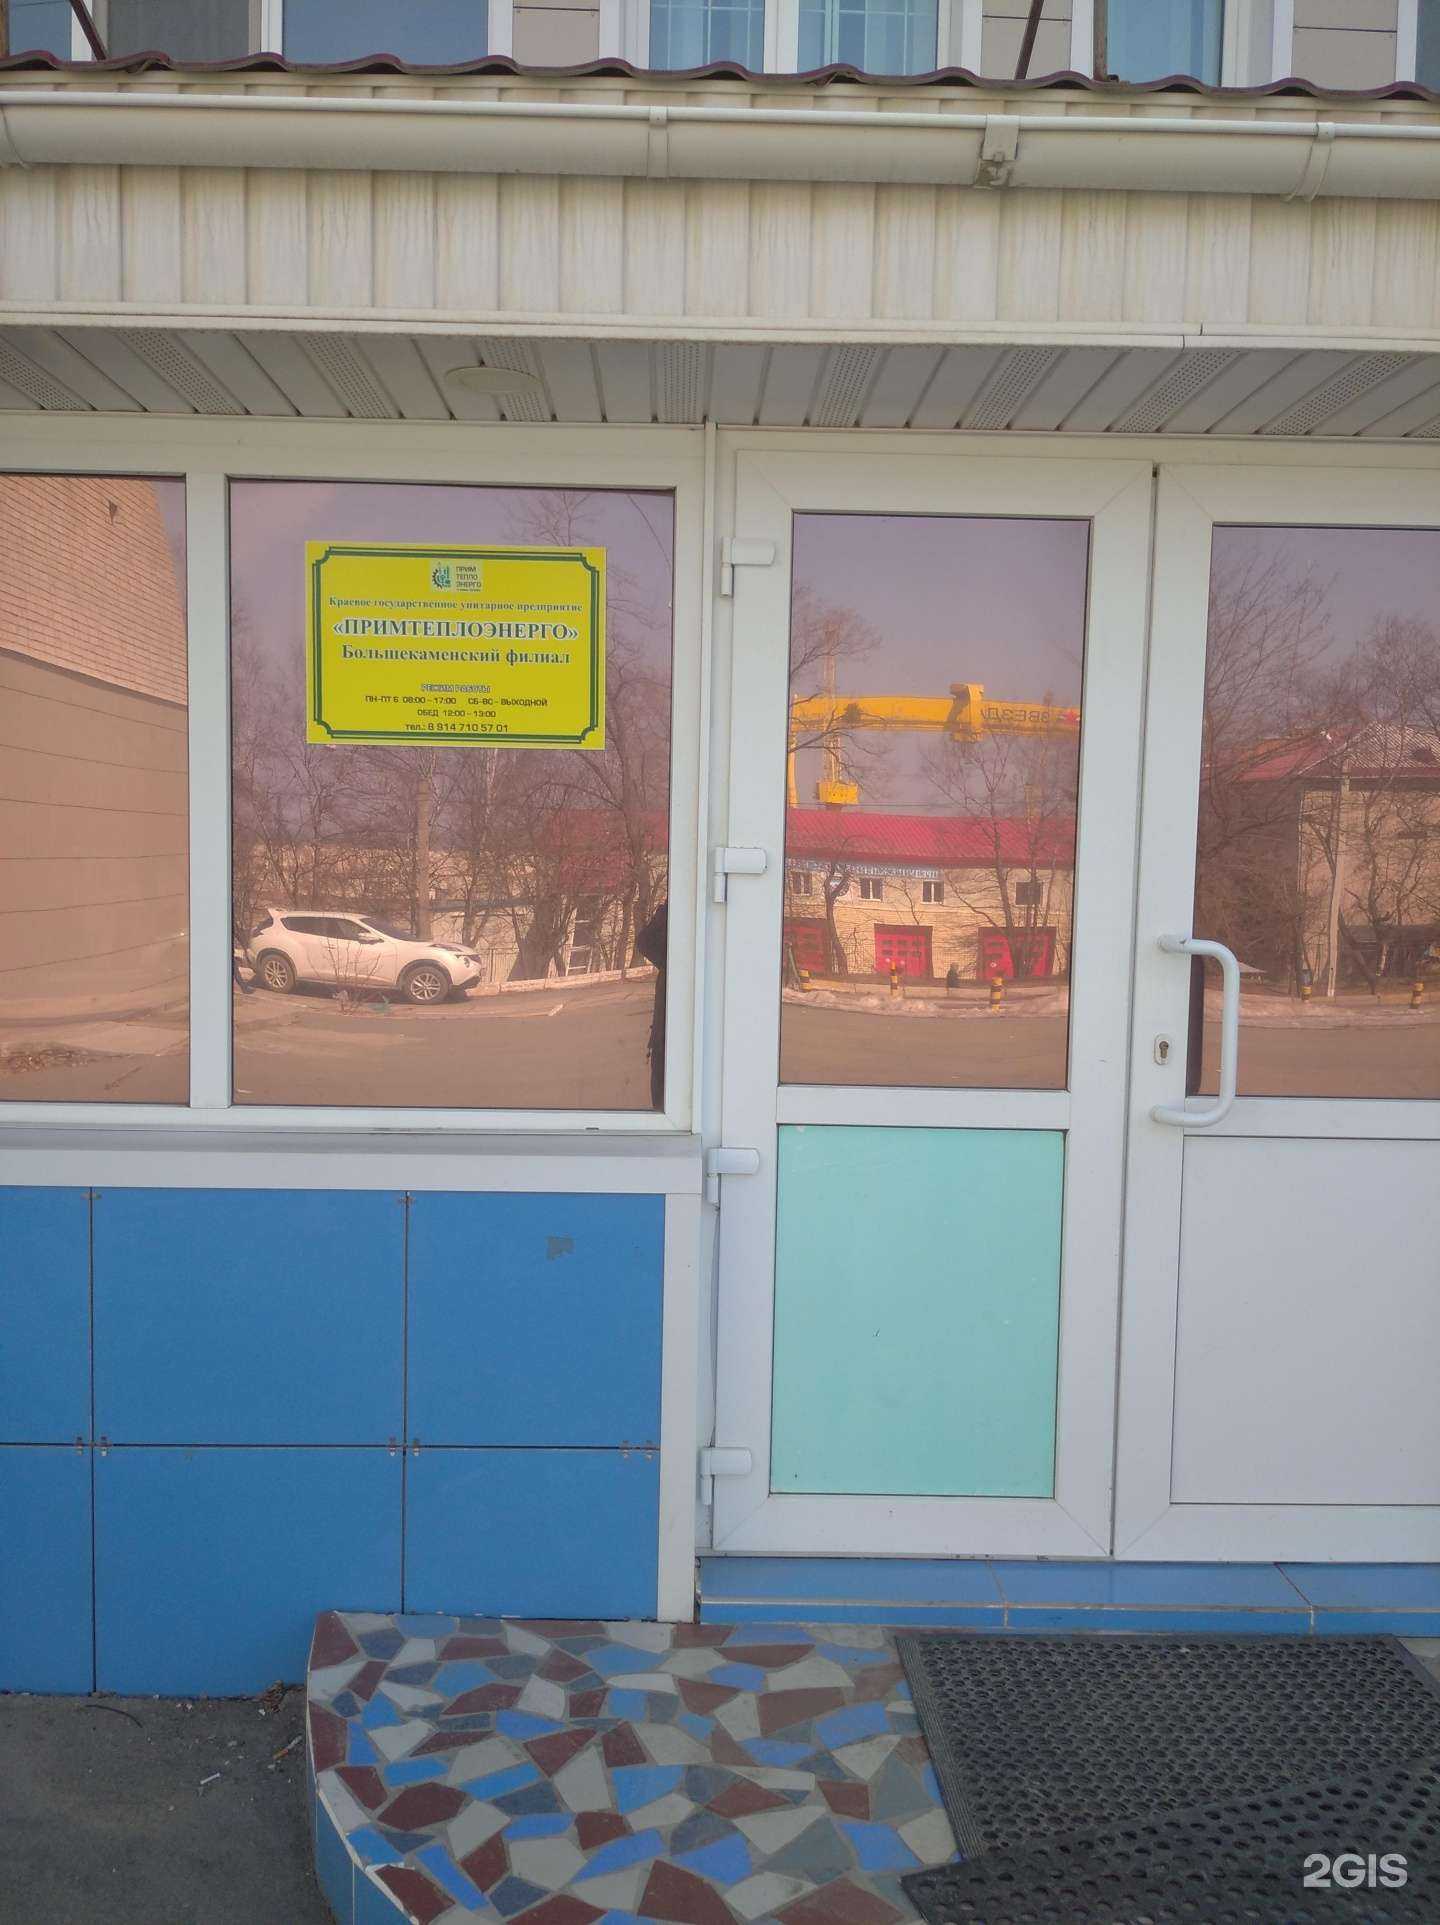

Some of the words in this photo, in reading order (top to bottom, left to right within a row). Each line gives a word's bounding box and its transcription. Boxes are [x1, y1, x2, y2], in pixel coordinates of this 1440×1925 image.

[455, 573, 479, 581] ТЕПЛО
[455, 581, 482, 589] ЭНЕРГО
[329, 597, 370, 608] Краевое
[373, 599, 458, 611] государственное
[460, 601, 514, 612] унитарное
[517, 602, 583, 613] предприятие
[333, 618, 578, 640] «ПРИМТЕПЛОЭНЕРГО»
[342, 645, 500, 662] Большекаменский
[505, 649, 571, 666] филиал
[402, 696, 426, 704] 08:00
[434, 697, 457, 705] 17:00
[467, 697, 494, 706] СБ-ВС
[500, 697, 548, 707] ВЫХОДНОЙ
[417, 709, 439, 718] ОБЕД
[443, 709, 466, 718] 12:00
[473, 710, 497, 718] 13:00
[428, 722, 434, 731] 8
[437, 722, 456, 732] 914
